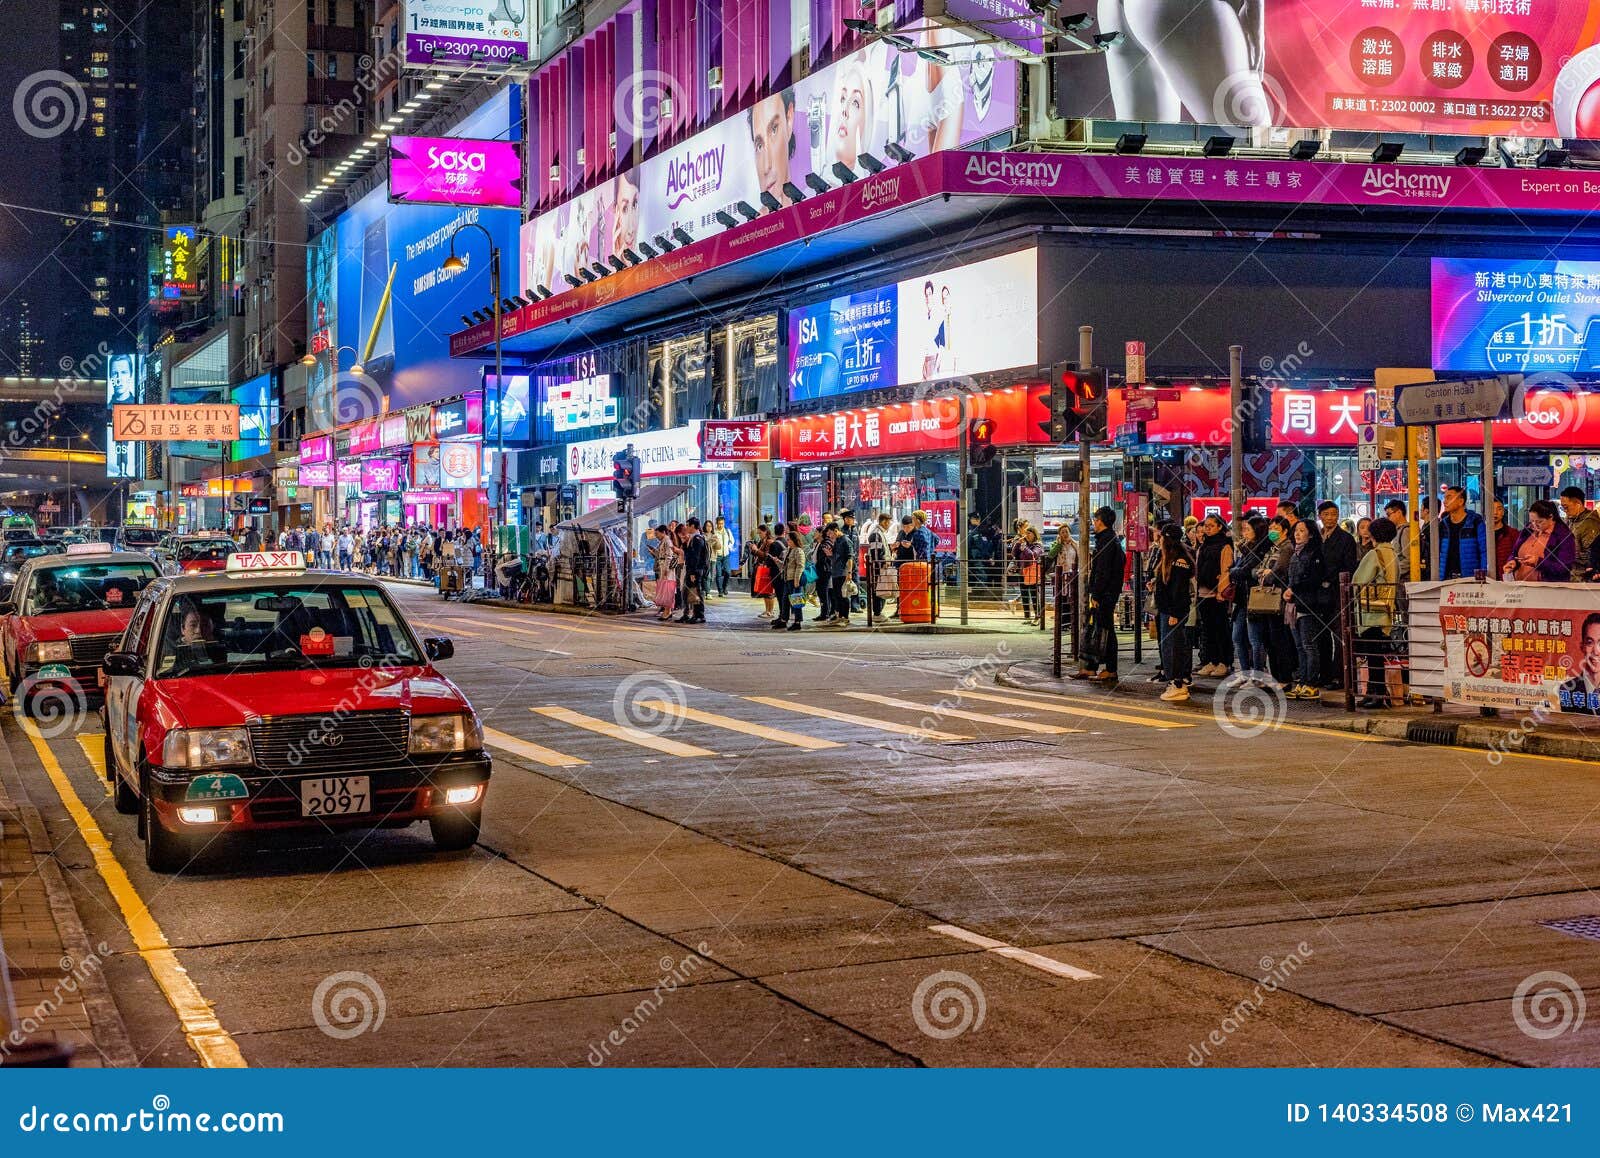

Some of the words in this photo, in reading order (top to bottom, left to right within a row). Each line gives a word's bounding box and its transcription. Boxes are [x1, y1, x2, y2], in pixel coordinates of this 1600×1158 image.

[1362, 38, 1393, 56] 激光
[1432, 41, 1462, 59] 排水
[1500, 45, 1530, 62] 孕婦
[1362, 59, 1393, 76] 溶脂
[1500, 65, 1529, 82] 適用
[1332, 97, 1368, 112] 廣東道
[1369, 99, 1380, 112] T:
[1381, 100, 1407, 113] 2302
[1409, 102, 1436, 114] 0002
[1443, 102, 1477, 117] 漢口道
[1479, 104, 1490, 116] T:
[1491, 105, 1517, 117] 3622
[1519, 105, 1545, 118] 2783
[667, 144, 726, 197] Alchemy
[964, 155, 1062, 187] Alchemy
[862, 176, 900, 203] Alchemy
[1362, 167, 1452, 199] Alchemy
[1521, 179, 1561, 195] Expert
[1564, 183, 1579, 193] on
[809, 206, 823, 219] Since
[823, 200, 836, 214] 1994
[405, 244, 415, 262] The
[416, 240, 427, 257] new
[426, 231, 442, 254] super
[413, 270, 436, 297] SAMSUNG
[1477, 290, 1534, 303] Silvercord
[1537, 291, 1571, 303] Outlet
[798, 316, 819, 345] ISA
[1520, 311, 1567, 346] 1折
[576, 354, 597, 381] ISA
[1497, 353, 1513, 363] UP
[1515, 353, 1530, 363] TO
[1533, 353, 1555, 364] 90%
[1558, 353, 1580, 364] OFF
[1425, 386, 1453, 399] Canton
[1453, 383, 1475, 397] Road
[150, 409, 233, 421] TIMECITY
[714, 427, 762, 442] 周大福
[834, 412, 880, 450] 周大福
[888, 422, 908, 434] CHOW
[909, 420, 921, 432] TAI
[921, 417, 941, 431] FOOK
[651, 444, 675, 463] CHINA
[236, 552, 298, 568] TAXI
[210, 778, 223, 792] 4
[322, 777, 350, 796] UX
[308, 794, 366, 815] 2097
